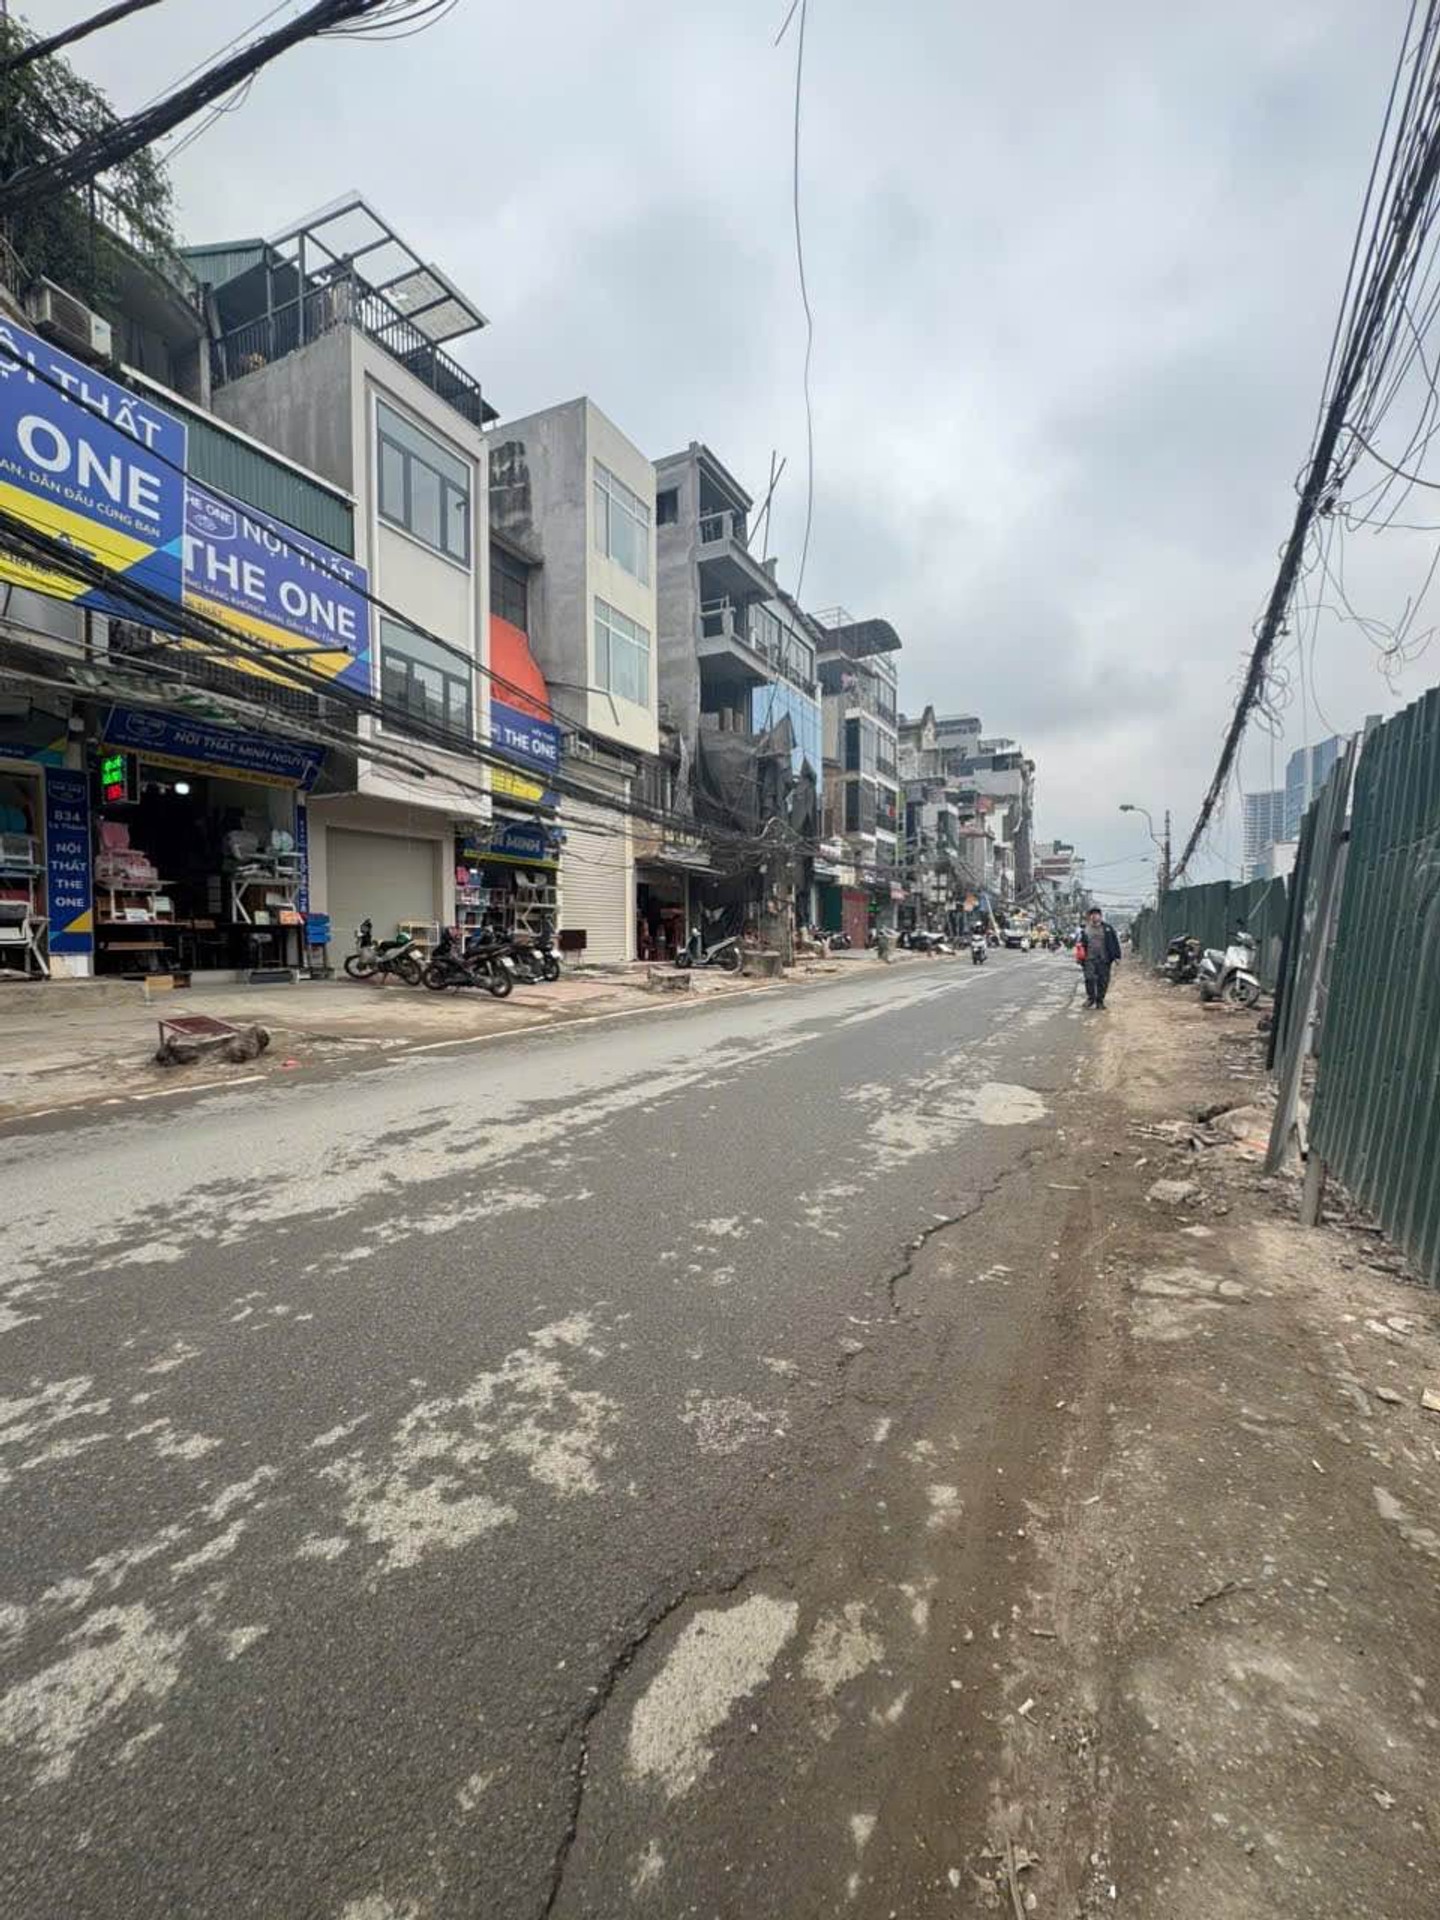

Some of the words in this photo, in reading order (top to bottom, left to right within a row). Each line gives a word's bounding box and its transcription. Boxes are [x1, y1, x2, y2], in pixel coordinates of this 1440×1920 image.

[50, 364, 162, 448] THẤT
[17, 414, 162, 521] ONE
[206, 503, 233, 526] ONE
[243, 516, 288, 558] NỘI
[184, 536, 267, 603] THE
[279, 580, 357, 641] ONE
[503, 727, 530, 752] THE
[532, 738, 557, 761] ONE
[55, 842, 81, 855] NỘI
[50, 858, 87, 872] THẤT
[55, 878, 85, 890] THE
[54, 896, 86, 908] ONE
